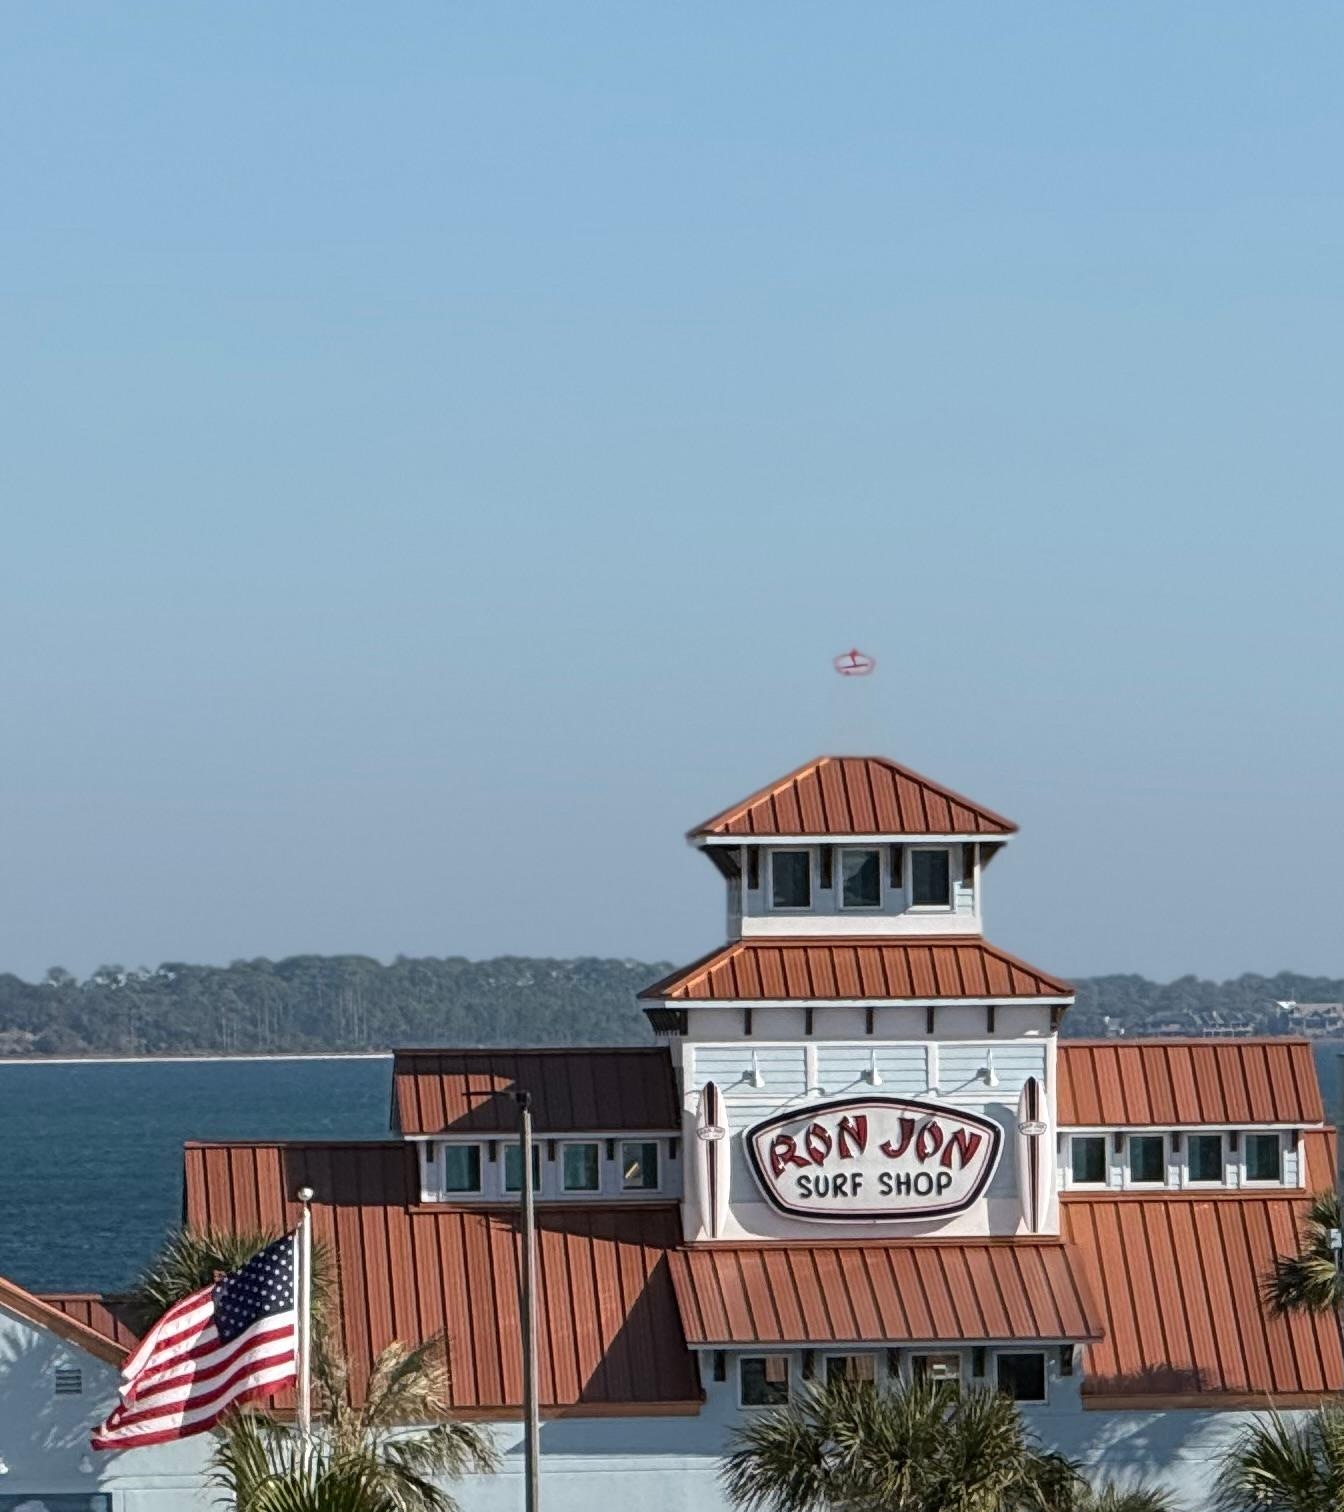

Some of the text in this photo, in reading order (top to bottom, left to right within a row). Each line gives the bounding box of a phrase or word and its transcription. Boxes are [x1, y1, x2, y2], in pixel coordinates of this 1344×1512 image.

[771, 1114, 983, 1179] RON JON
[797, 1171, 953, 1199] SURF SHOP
